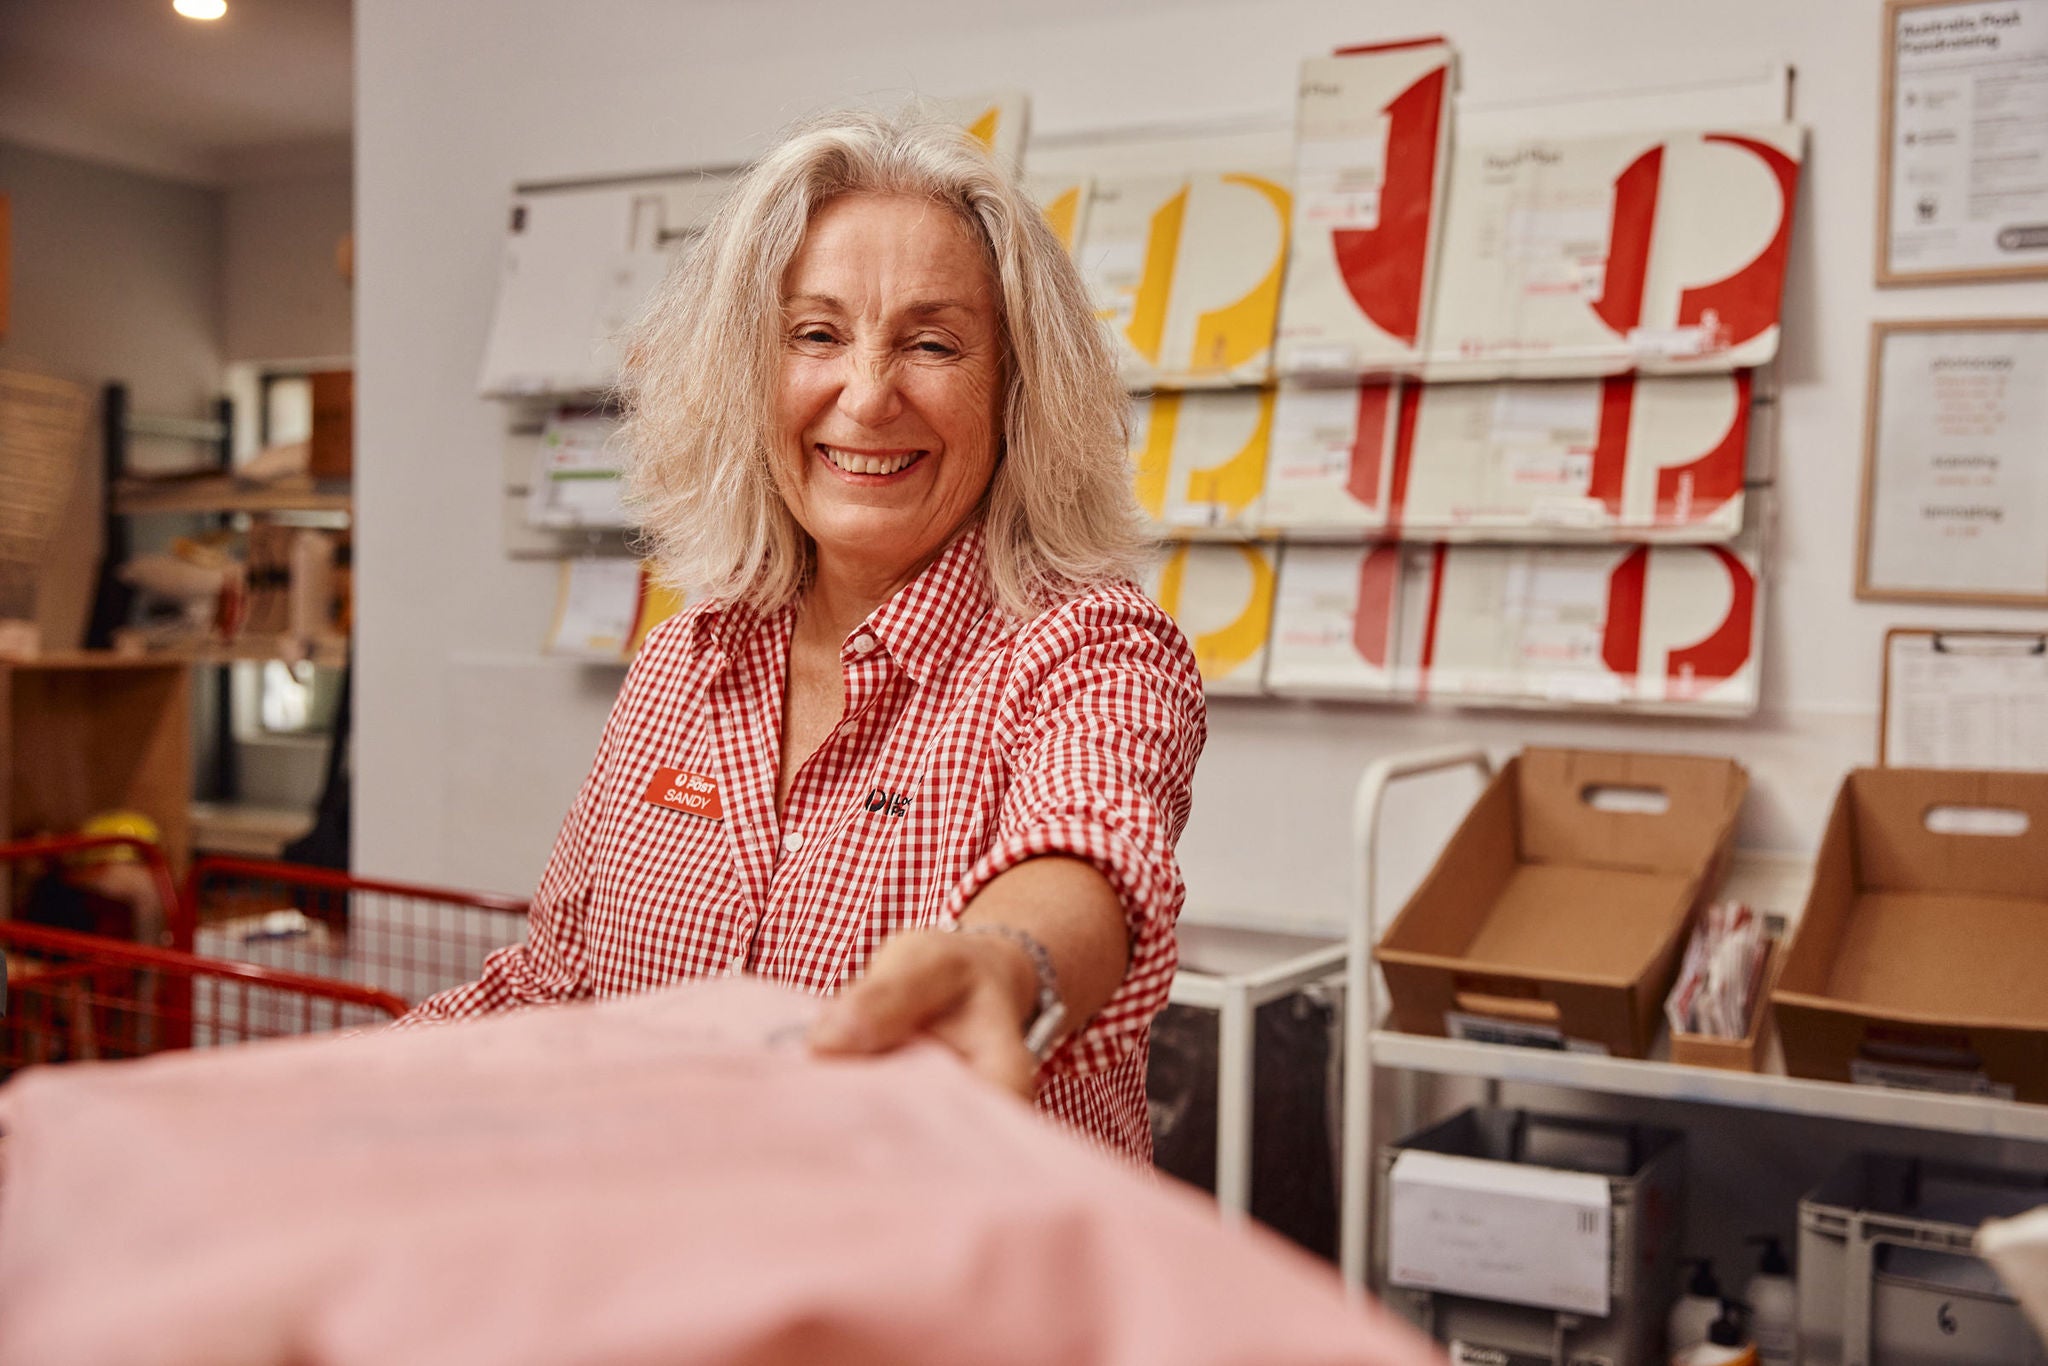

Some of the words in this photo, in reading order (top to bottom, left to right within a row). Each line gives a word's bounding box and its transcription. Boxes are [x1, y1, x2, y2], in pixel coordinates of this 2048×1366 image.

[686, 779, 716, 794] POST
[664, 788, 711, 810] SANDY
[1937, 1301, 1957, 1336] 6
